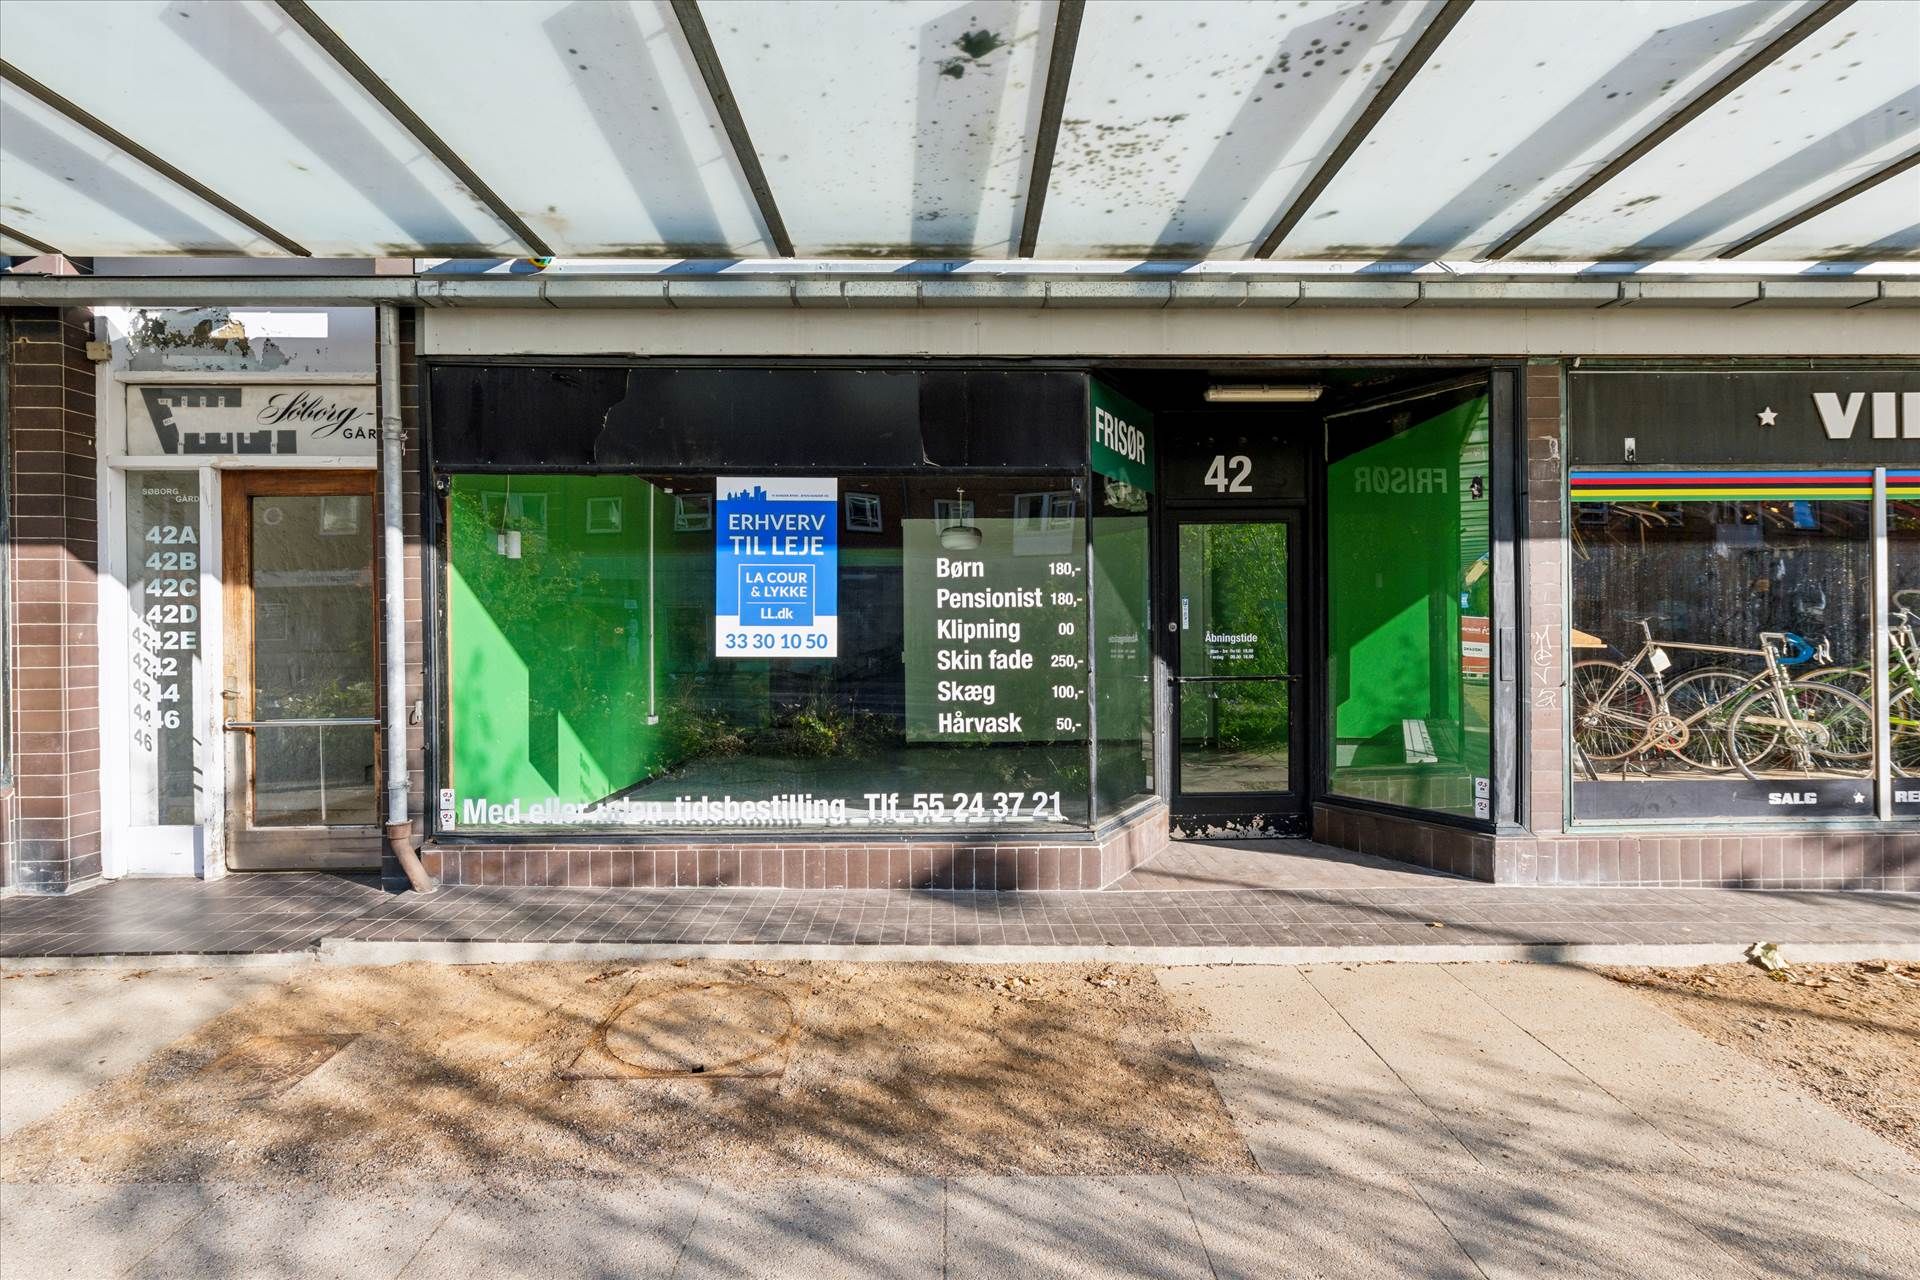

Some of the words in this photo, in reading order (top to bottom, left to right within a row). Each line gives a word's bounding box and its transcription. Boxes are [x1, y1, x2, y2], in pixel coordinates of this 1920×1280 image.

[1095, 406, 1146, 466] FRISØR
[1204, 455, 1253, 493] 42
[142, 488, 180, 496] SØBORG
[175, 494, 200, 503] GÅRD
[728, 513, 826, 531] ERHVERV
[145, 525, 198, 545] 42A
[729, 535, 767, 556] TIL
[771, 535, 825, 556] LEJE
[145, 552, 198, 571] 42B
[936, 557, 985, 579] Børn
[1049, 562, 1082, 578] 180,-
[145, 578, 198, 598] 42C
[745, 572, 765, 584] LA
[767, 572, 808, 584] COUR
[750, 585, 761, 598] &
[764, 586, 808, 598] LYKKE
[936, 587, 1043, 609] Pensionist
[1050, 592, 1083, 608] 180,-
[145, 604, 198, 624] 42D
[760, 607, 794, 620] LL.dk
[725, 633, 748, 649] 33
[752, 633, 776, 649] 30
[780, 633, 802, 649] 10
[805, 633, 829, 649] 50
[937, 618, 1021, 644] Klipning
[1058, 622, 1075, 636] 00
[1204, 630, 1258, 644] Åbningstide
[937, 649, 983, 671] Skin
[988, 648, 1034, 669] fade
[1050, 654, 1084, 669] 250,-
[937, 680, 996, 706] Skæg
[1051, 685, 1085, 700] 100,-
[938, 710, 1023, 734] Hårvask
[1056, 717, 1082, 733] 50,-
[463, 798, 520, 825] Med
[673, 793, 846, 824] tidsbestilling
[864, 793, 906, 821] Tlf.
[913, 793, 945, 818] 55
[952, 792, 985, 818] 24
[993, 792, 1025, 817] 37
[1032, 791, 1063, 819] 21
[1768, 792, 1818, 805] SALG
